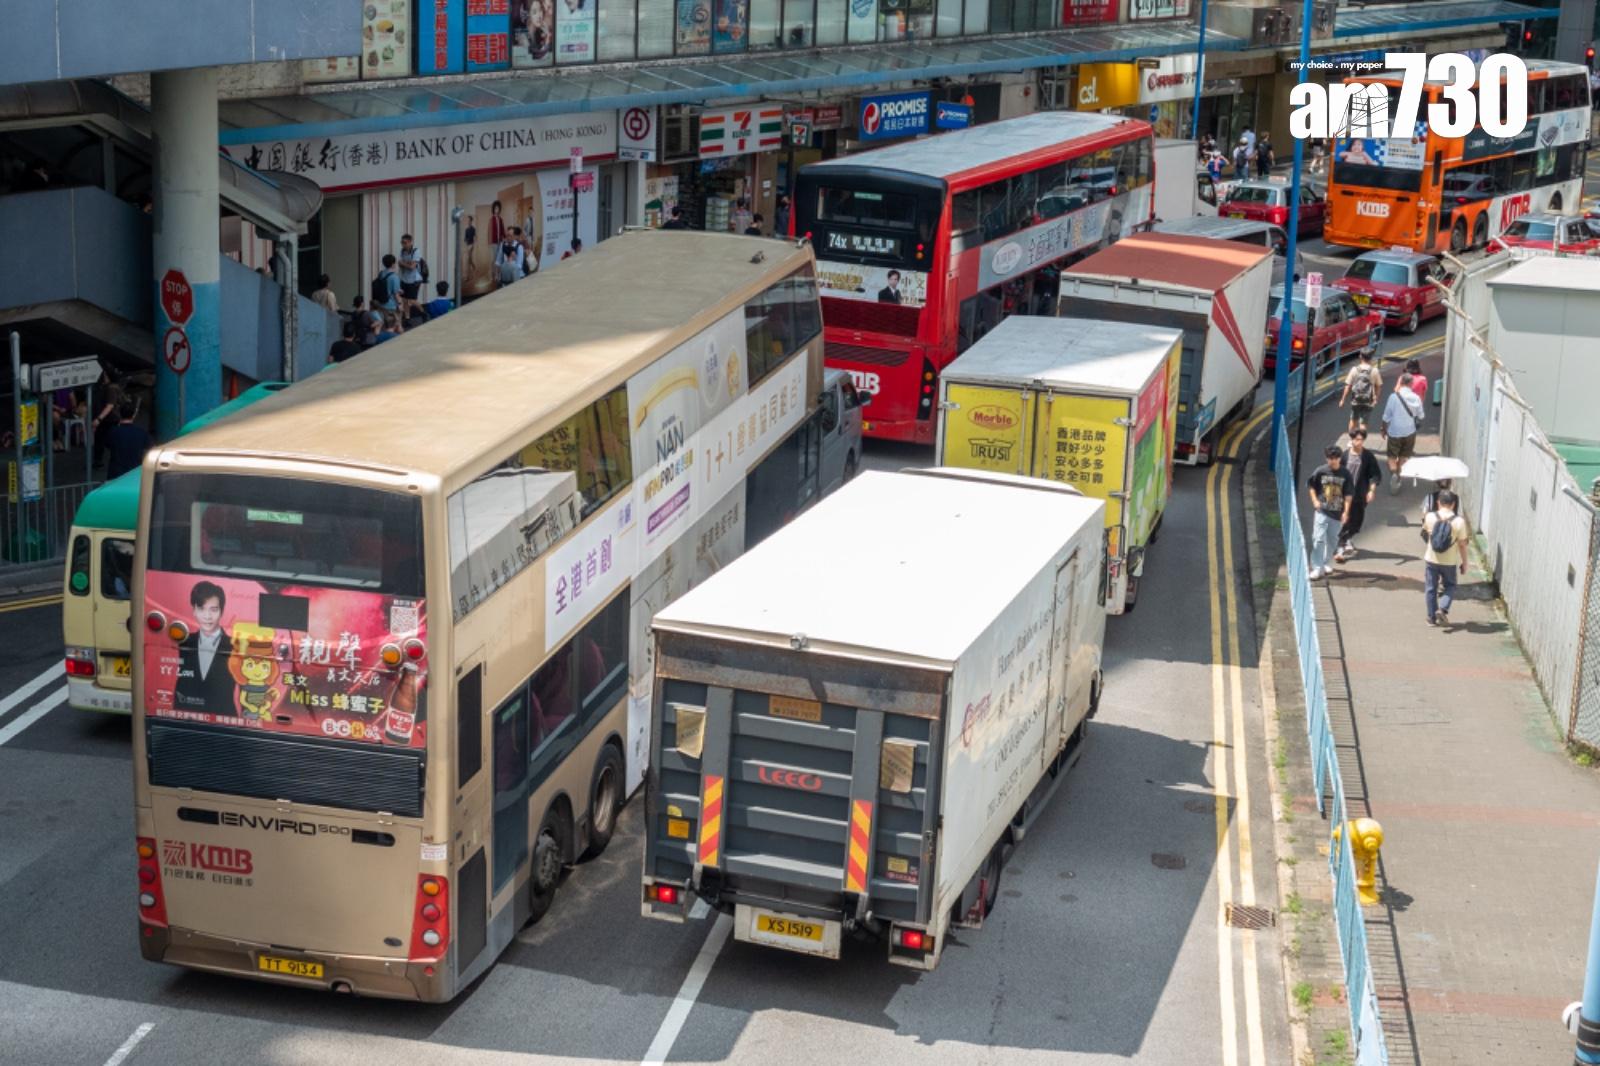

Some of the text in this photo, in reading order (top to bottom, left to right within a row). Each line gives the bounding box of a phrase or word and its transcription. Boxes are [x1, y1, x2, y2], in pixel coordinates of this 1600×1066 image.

[881, 98, 927, 118] PROMISE
[395, 138, 448, 161] BANK
[452, 134, 474, 155] OF
[479, 128, 536, 152] CHINA
[542, 127, 573, 144] (HONG
[575, 122, 607, 140] KONG)
[1357, 201, 1390, 218] KMB
[1501, 193, 1531, 229] KMB
[166, 280, 188, 297] STOP
[846, 369, 880, 395] MB
[656, 420, 684, 466] NAN
[1057, 427, 1106, 442] 香港品牌
[968, 438, 1016, 462] TRUST
[556, 534, 612, 615] 全港首創
[290, 689, 329, 707] Miss
[191, 844, 253, 875] KMB
[265, 958, 318, 976] TT 9134
